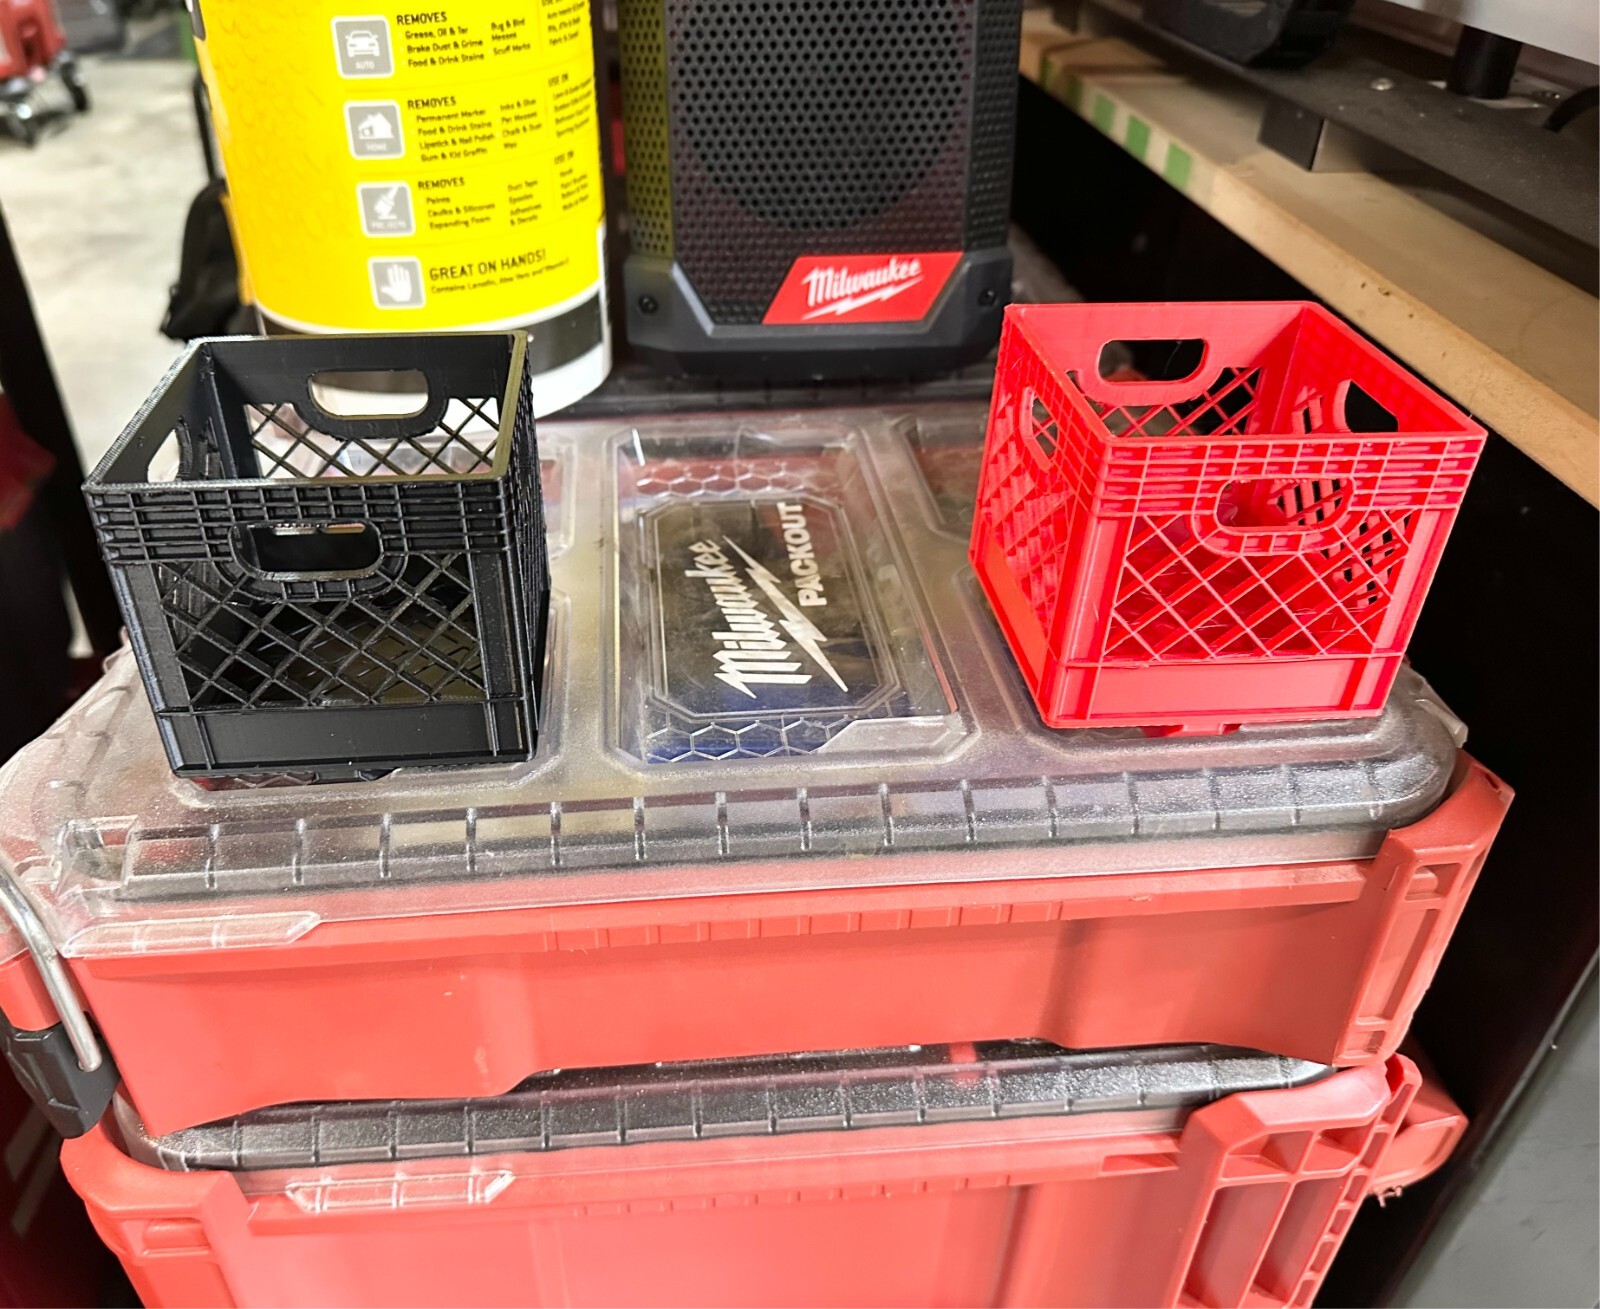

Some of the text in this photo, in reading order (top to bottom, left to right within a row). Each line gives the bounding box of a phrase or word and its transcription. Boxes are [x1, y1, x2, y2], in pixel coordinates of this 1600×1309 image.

[396, 12, 448, 26] REMOVES
[405, 26, 468, 40] Grease, Oil & Tar
[407, 39, 483, 54] Brake Dust & Grime
[356, 61, 374, 70] AUTO
[408, 52, 484, 68] Food & Drink Stains
[407, 96, 456, 110] REMOVES
[416, 109, 486, 122] Permanent Marker
[418, 128, 437, 136] Food
[448, 124, 467, 134] Drink
[470, 121, 492, 130] Stains
[420, 140, 449, 150] Lipstick
[452, 138, 457, 146] &
[459, 136, 472, 144] Nail
[421, 154, 439, 162] Gum
[450, 150, 461, 158] Kid
[418, 176, 465, 190] REMOVES
[426, 196, 450, 205] Paints
[456, 206, 462, 214] &
[430, 216, 491, 231] Expanding Foam
[430, 264, 474, 281] GREAT
[478, 260, 496, 276] ON
[500, 248, 546, 270] HANDS!
[430, 284, 466, 294] Contains
[801, 256, 922, 308] Milwaukee
[776, 502, 827, 608] PACKOUT
[685, 540, 812, 699] Milwaukee
